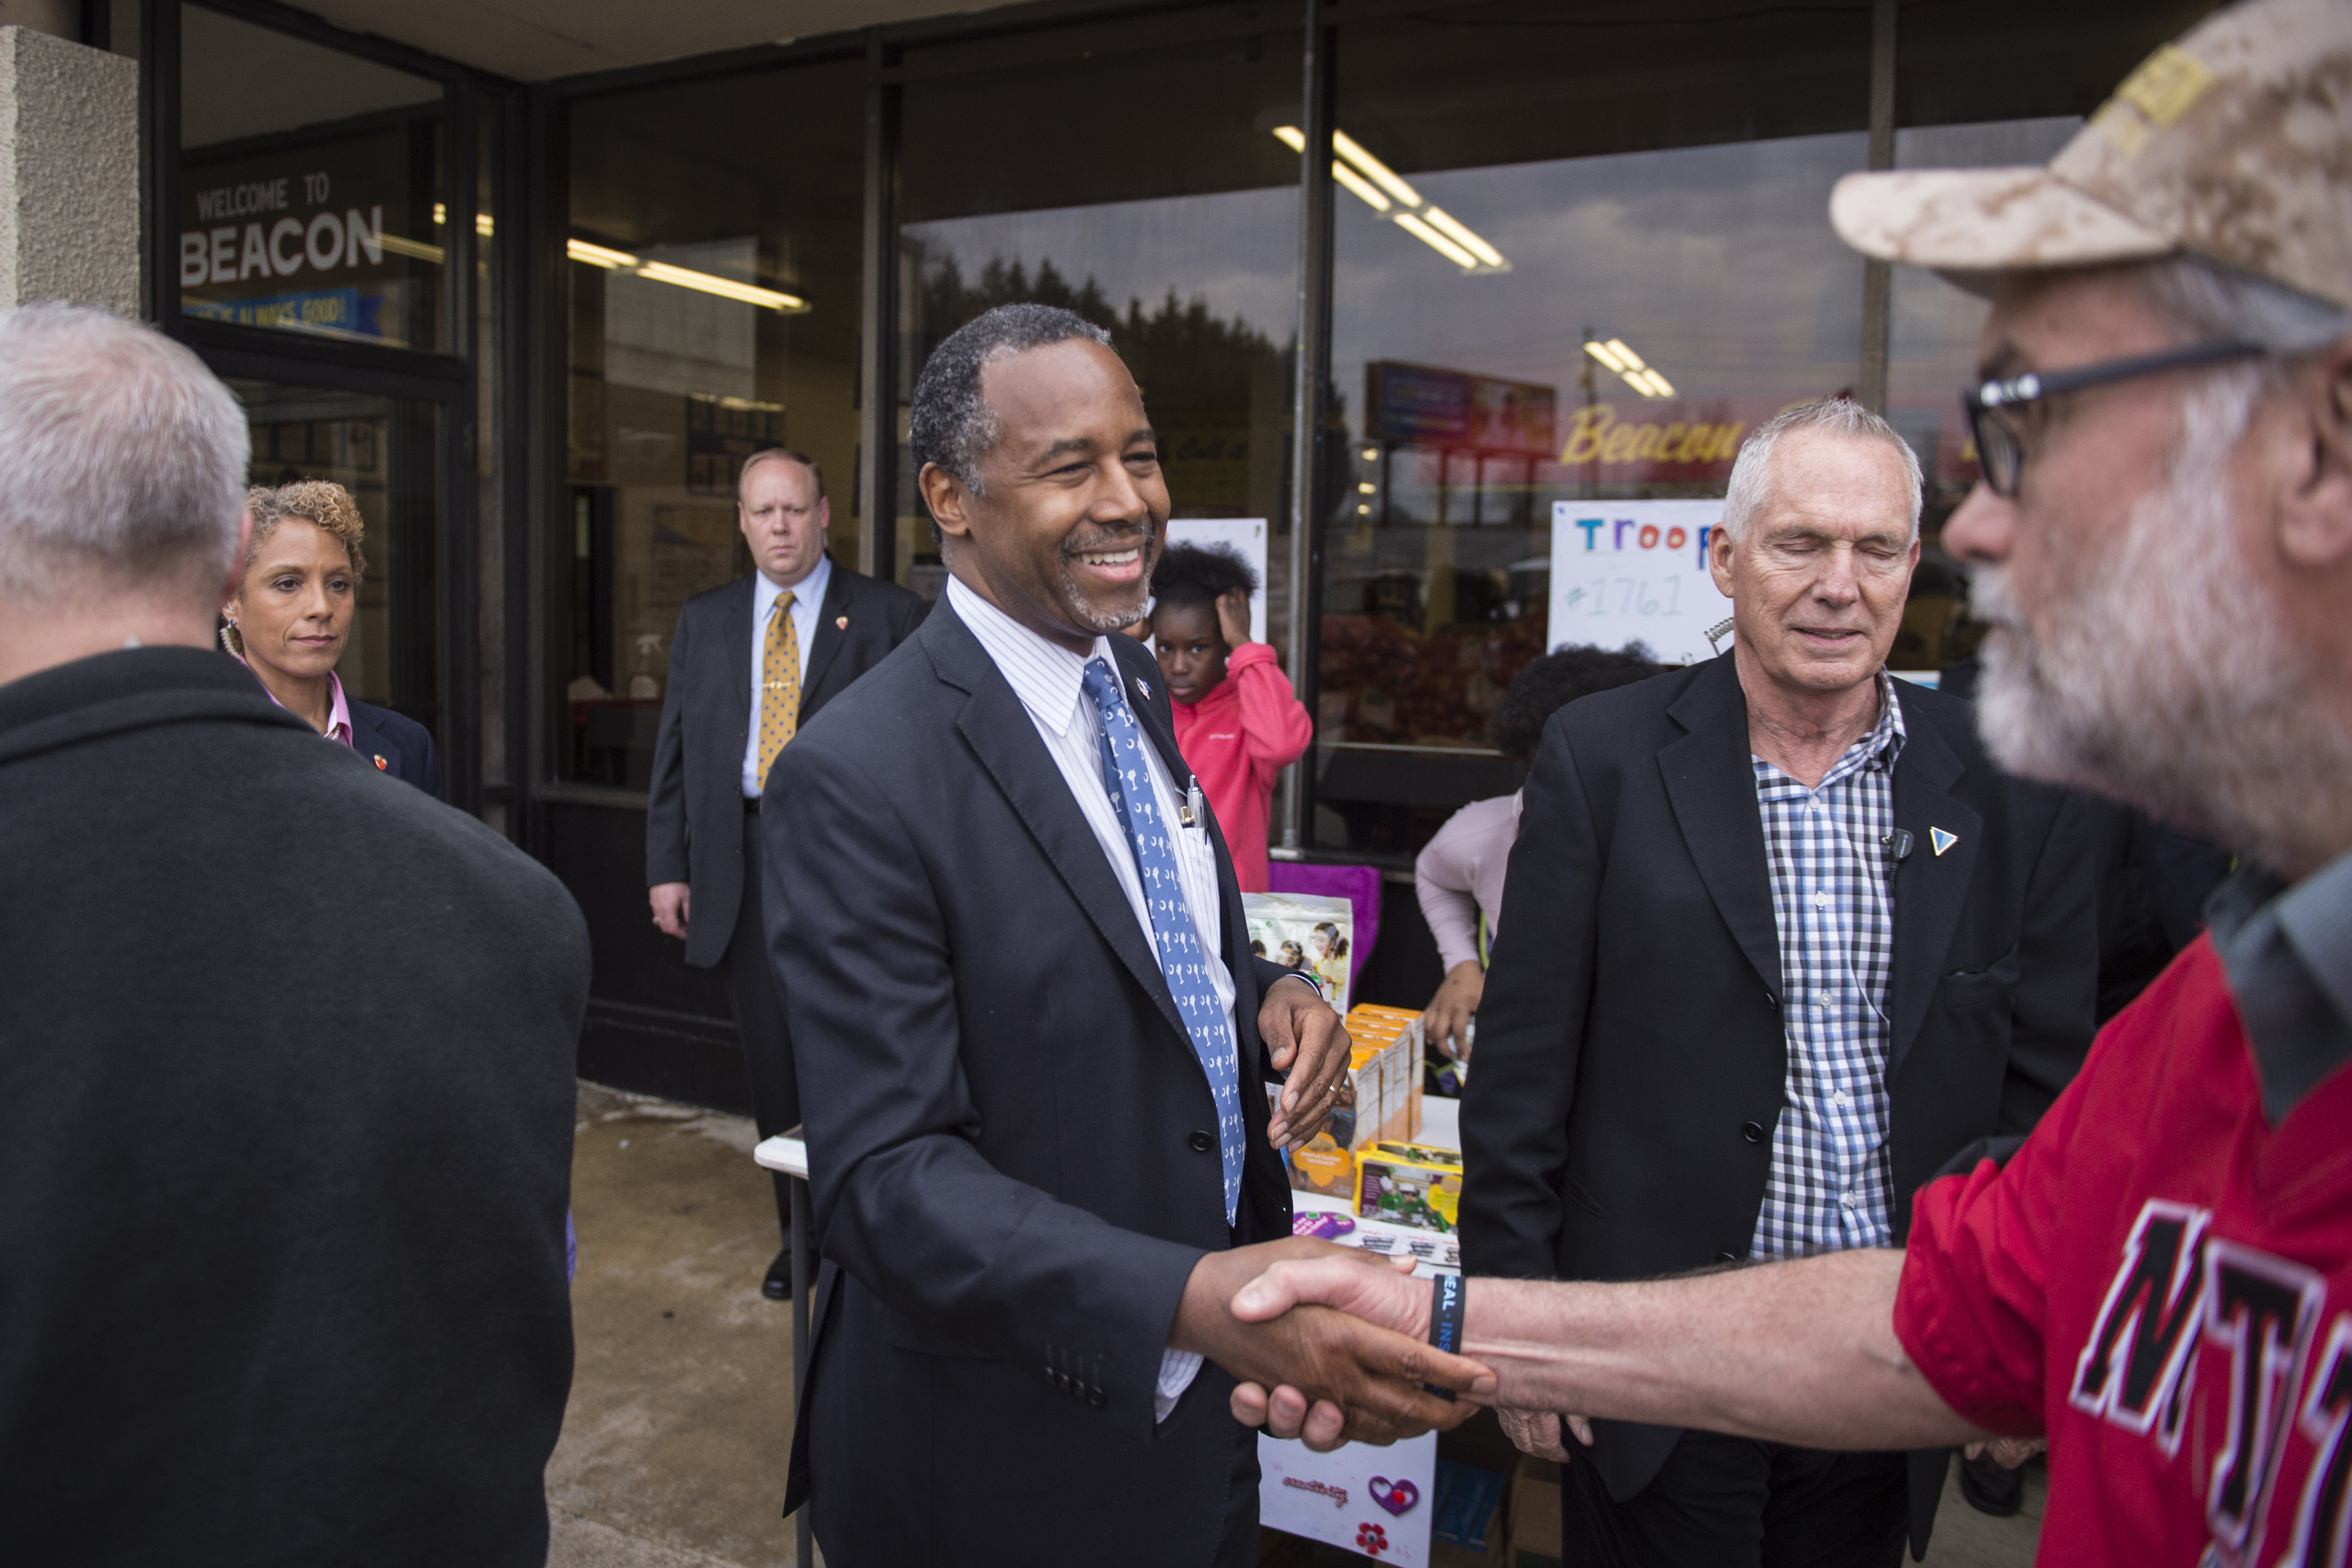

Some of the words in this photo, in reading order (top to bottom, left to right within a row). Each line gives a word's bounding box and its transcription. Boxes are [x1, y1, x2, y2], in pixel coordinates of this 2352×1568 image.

[197, 178, 288, 220] WELCOME
[305, 172, 330, 205] TO
[181, 206, 383, 287] BEACON
[1560, 404, 1745, 465] Beacon
[1565, 574, 1684, 615] #1761
